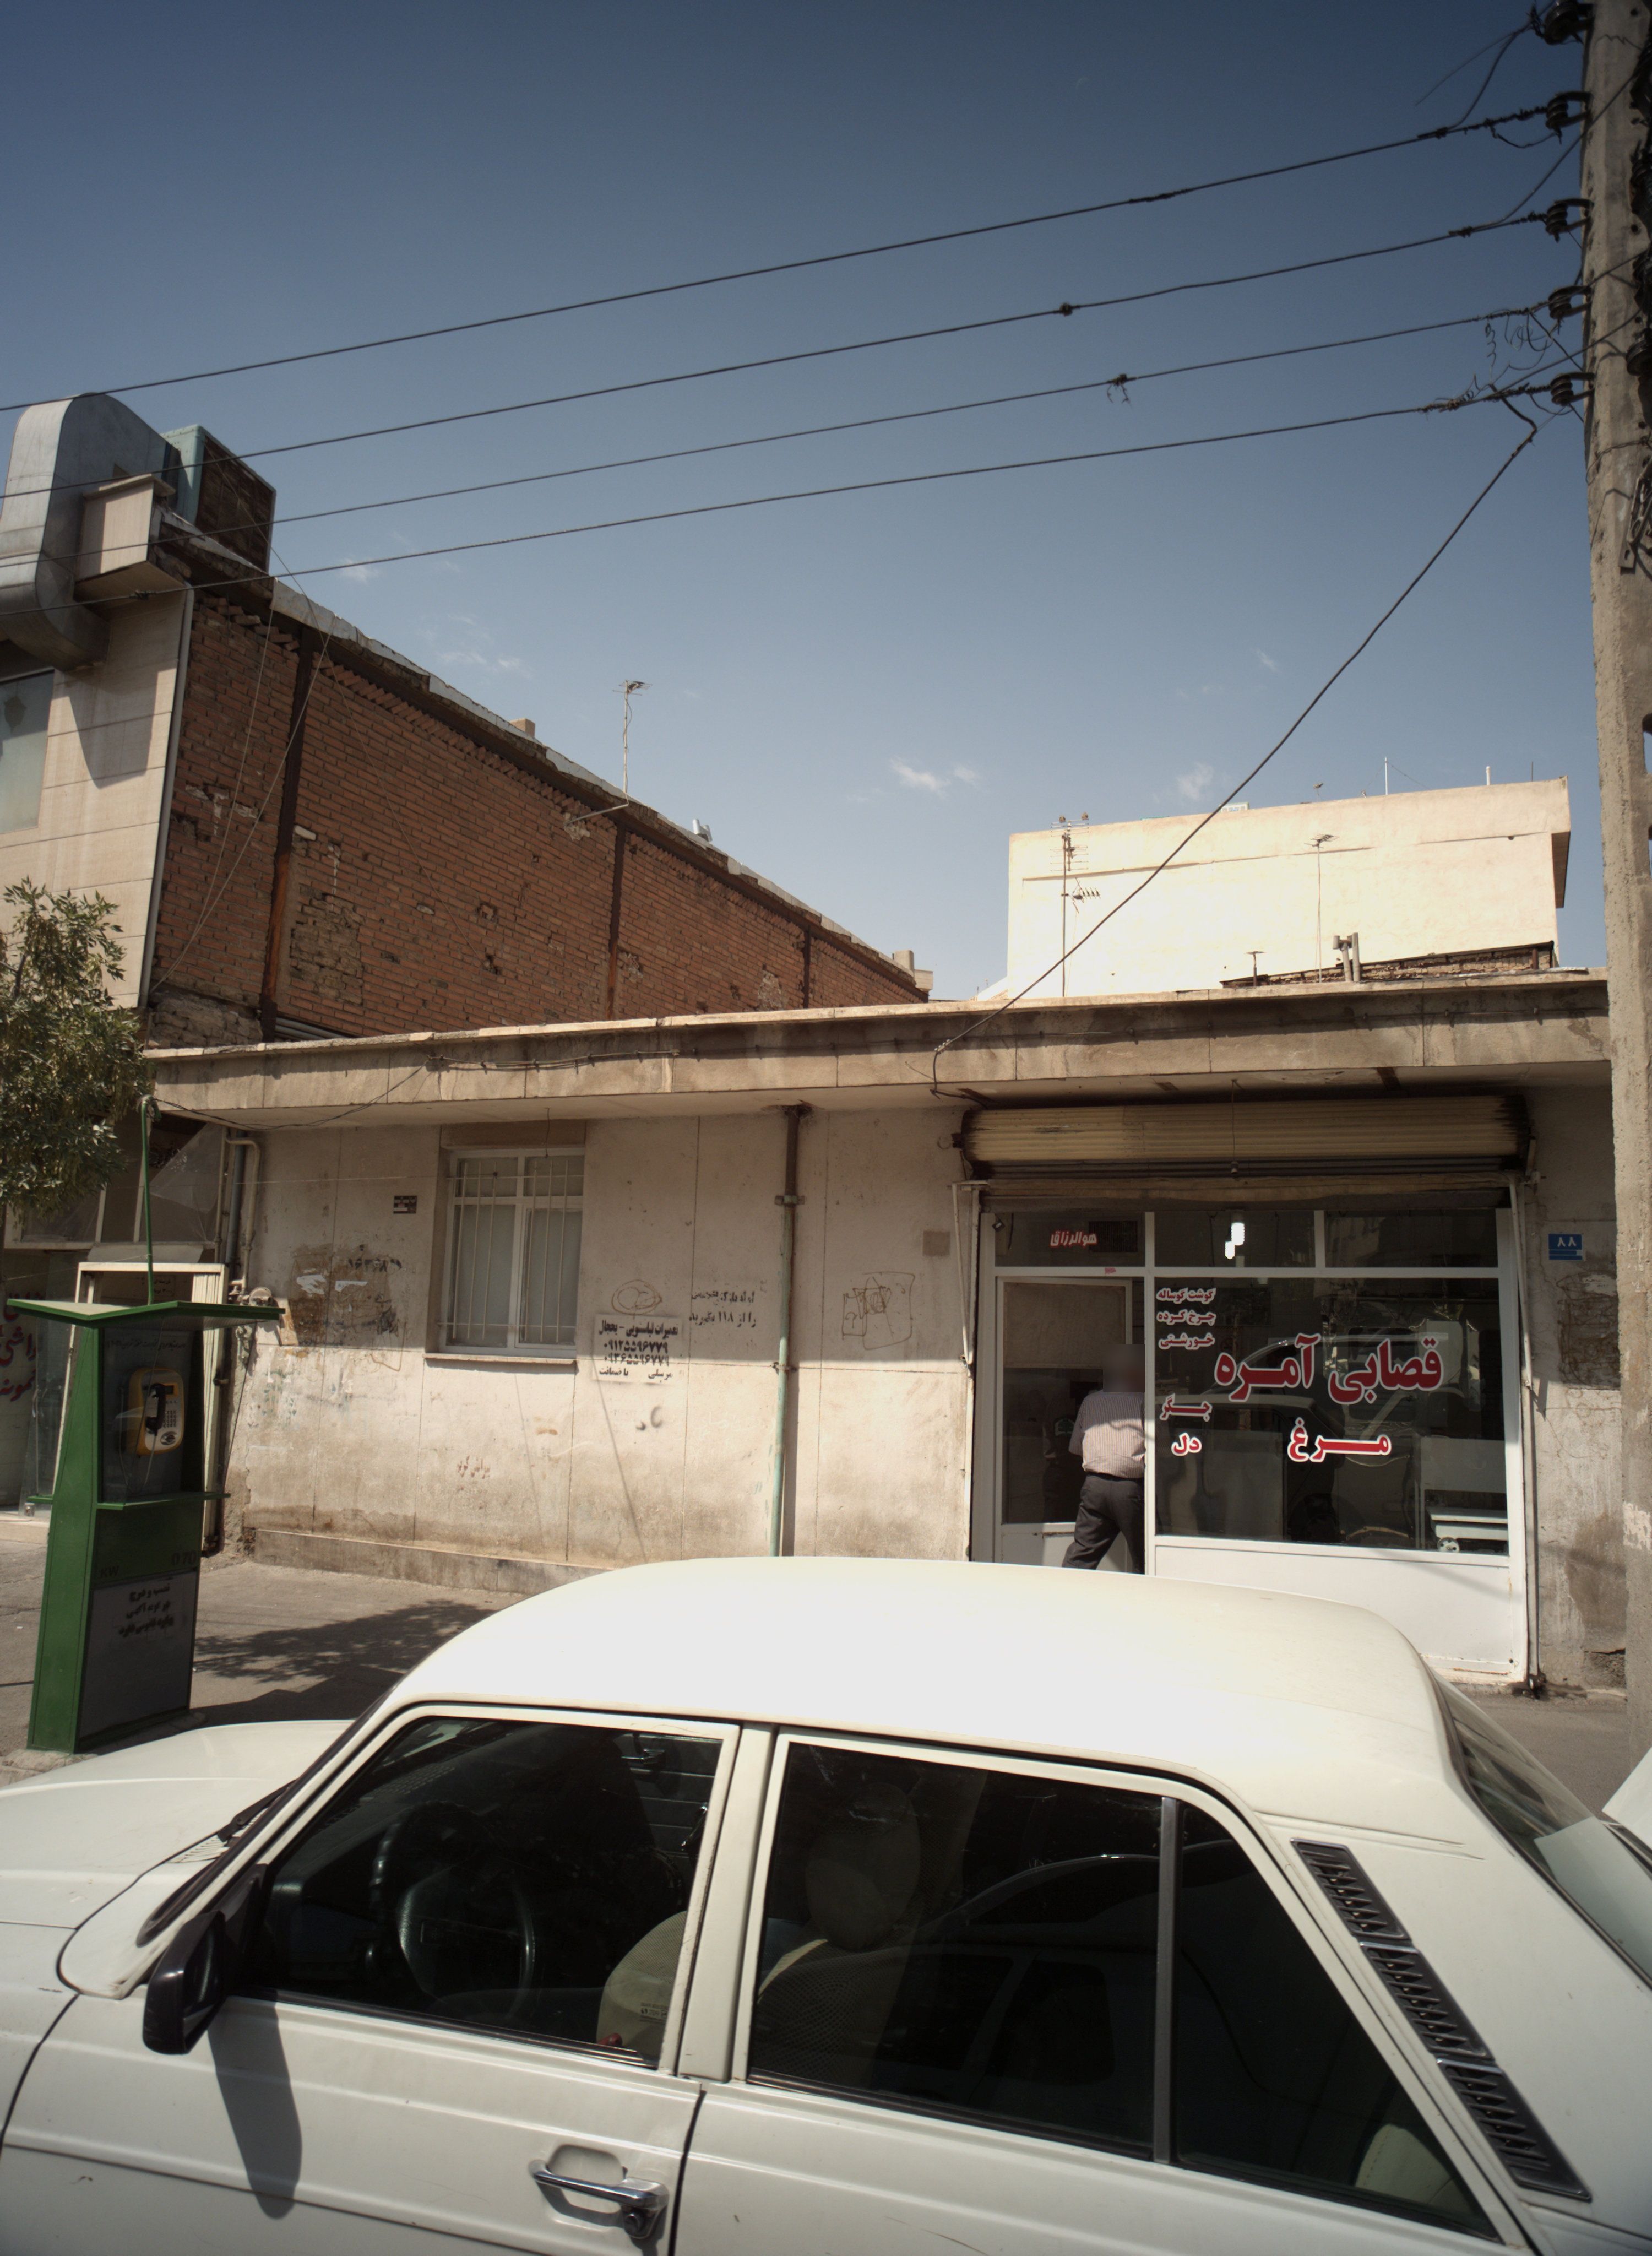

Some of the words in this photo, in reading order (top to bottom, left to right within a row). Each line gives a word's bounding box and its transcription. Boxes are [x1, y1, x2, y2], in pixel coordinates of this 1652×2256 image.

[1050, 1230, 1097, 1248] هوالرزاق
[1557, 1237, 1577, 1248] ۸۸
[1156, 1288, 1188, 1304] گوساله
[1187, 1288, 1216, 1304] گوشت
[1157, 1309, 1188, 1325] کرده
[1187, 1310, 1216, 1326] چرخ
[1159, 1333, 1215, 1350] خورشتی
[1328, 1337, 1444, 1404] قصابی
[1159, 1393, 1212, 1422] جگر
[1171, 1433, 1202, 1456] دل
[1287, 1417, 1392, 1462] مرغ
